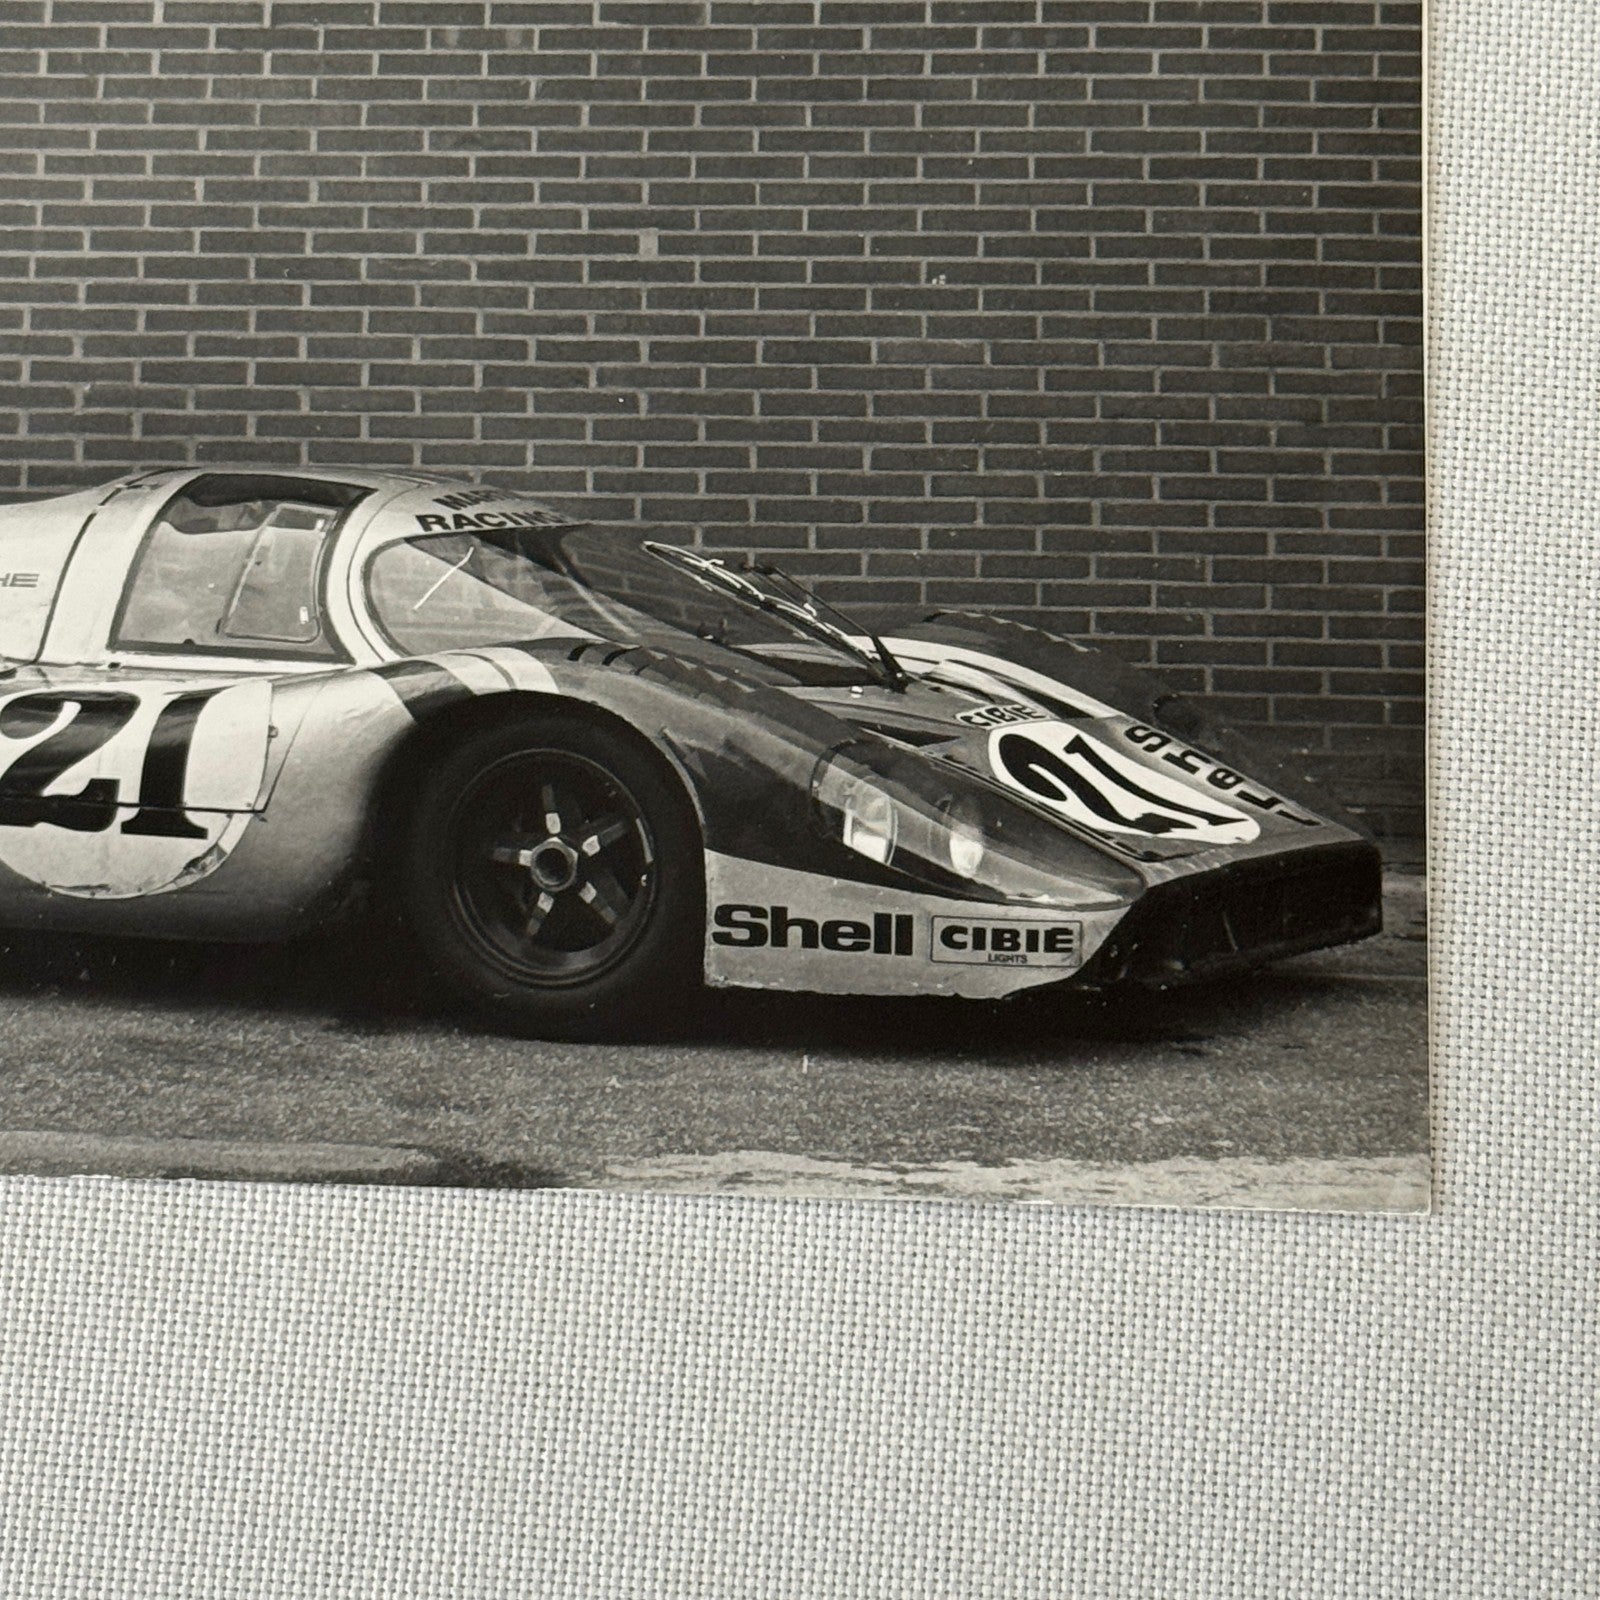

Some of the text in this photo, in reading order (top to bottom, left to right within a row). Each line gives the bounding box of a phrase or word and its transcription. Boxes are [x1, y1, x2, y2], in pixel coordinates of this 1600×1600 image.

[0, 690, 235, 840] 21
[998, 733, 1249, 835] 21
[1123, 724, 1322, 827] Shell
[712, 904, 913, 956] Shell
[988, 953, 1028, 964] LIGHTS
